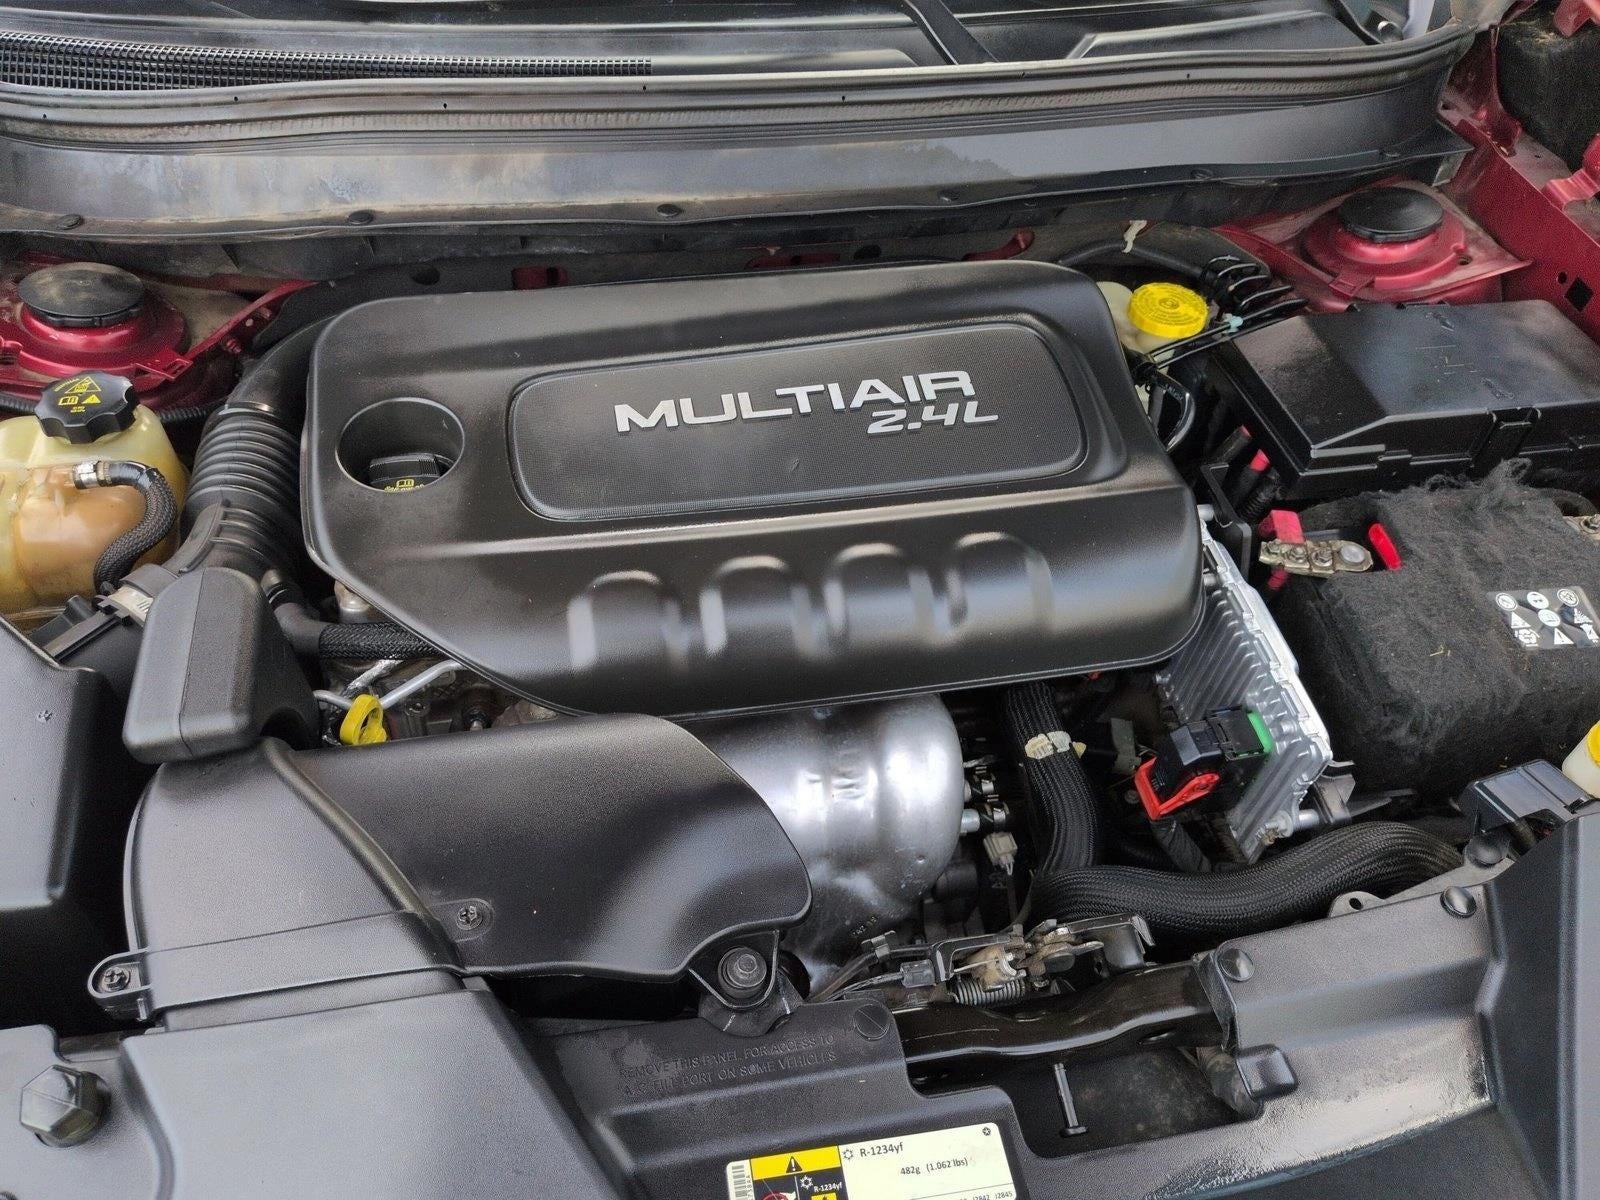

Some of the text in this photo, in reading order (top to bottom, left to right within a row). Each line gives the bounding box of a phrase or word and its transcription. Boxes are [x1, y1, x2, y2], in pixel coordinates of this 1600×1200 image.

[613, 370, 977, 433] MULTIAIR
[866, 401, 999, 435] 2.4L
[620, 1061, 670, 1080] REMOVE
[673, 1057, 701, 1071] THIS
[702, 1049, 738, 1067] PANEL
[744, 1045, 769, 1060] FOR
[770, 1036, 817, 1054] ACCESS
[682, 1070, 713, 1087] PORT
[717, 1067, 736, 1081] ON
[740, 1060, 775, 1077] SOME
[778, 1050, 837, 1071] VEHICLES
[860, 1141, 904, 1158] R-1234yf
[900, 1156, 968, 1176] 482g (1.062 lbs)
[813, 1181, 843, 1194] R-1234yf
